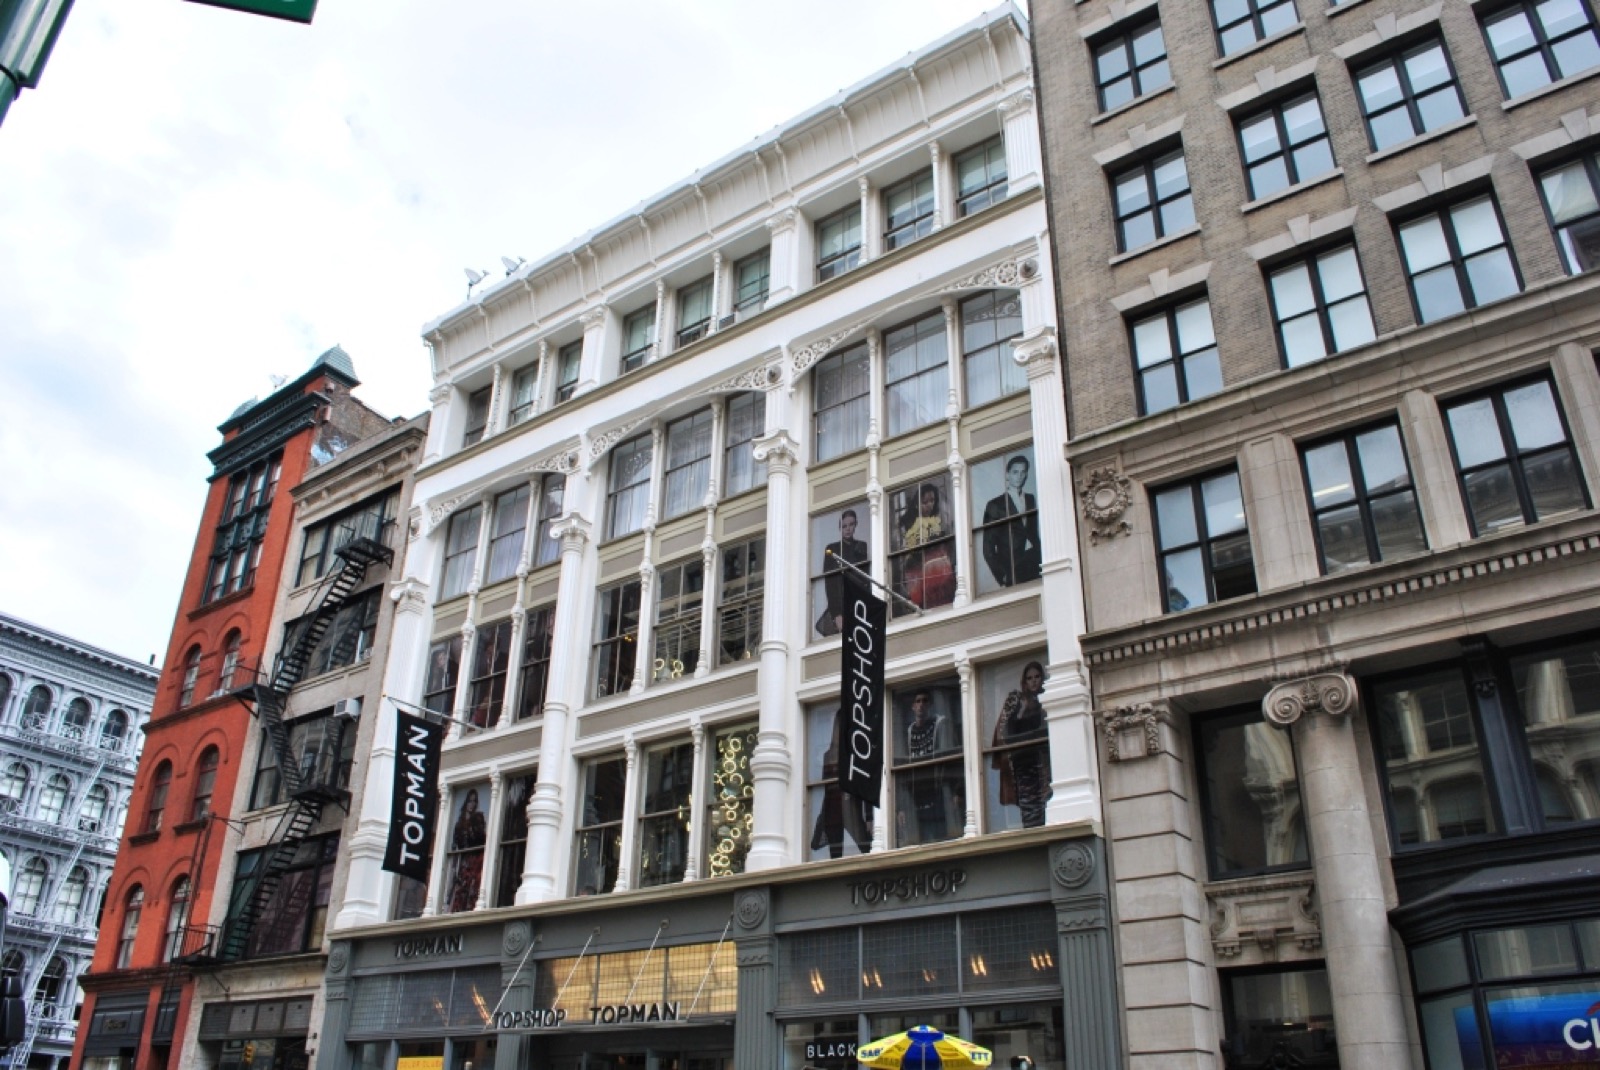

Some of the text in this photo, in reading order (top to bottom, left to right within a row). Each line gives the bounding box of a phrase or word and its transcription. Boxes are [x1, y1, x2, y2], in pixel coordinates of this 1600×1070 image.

[848, 599, 873, 781] TOPSHOP
[399, 724, 429, 866] TOPMAN
[846, 870, 967, 906] TOPSHOP
[394, 934, 463, 959] TOPMAN
[493, 1001, 681, 1030] TOPSHOP TOPMAN
[807, 1043, 856, 1058] BLACK
